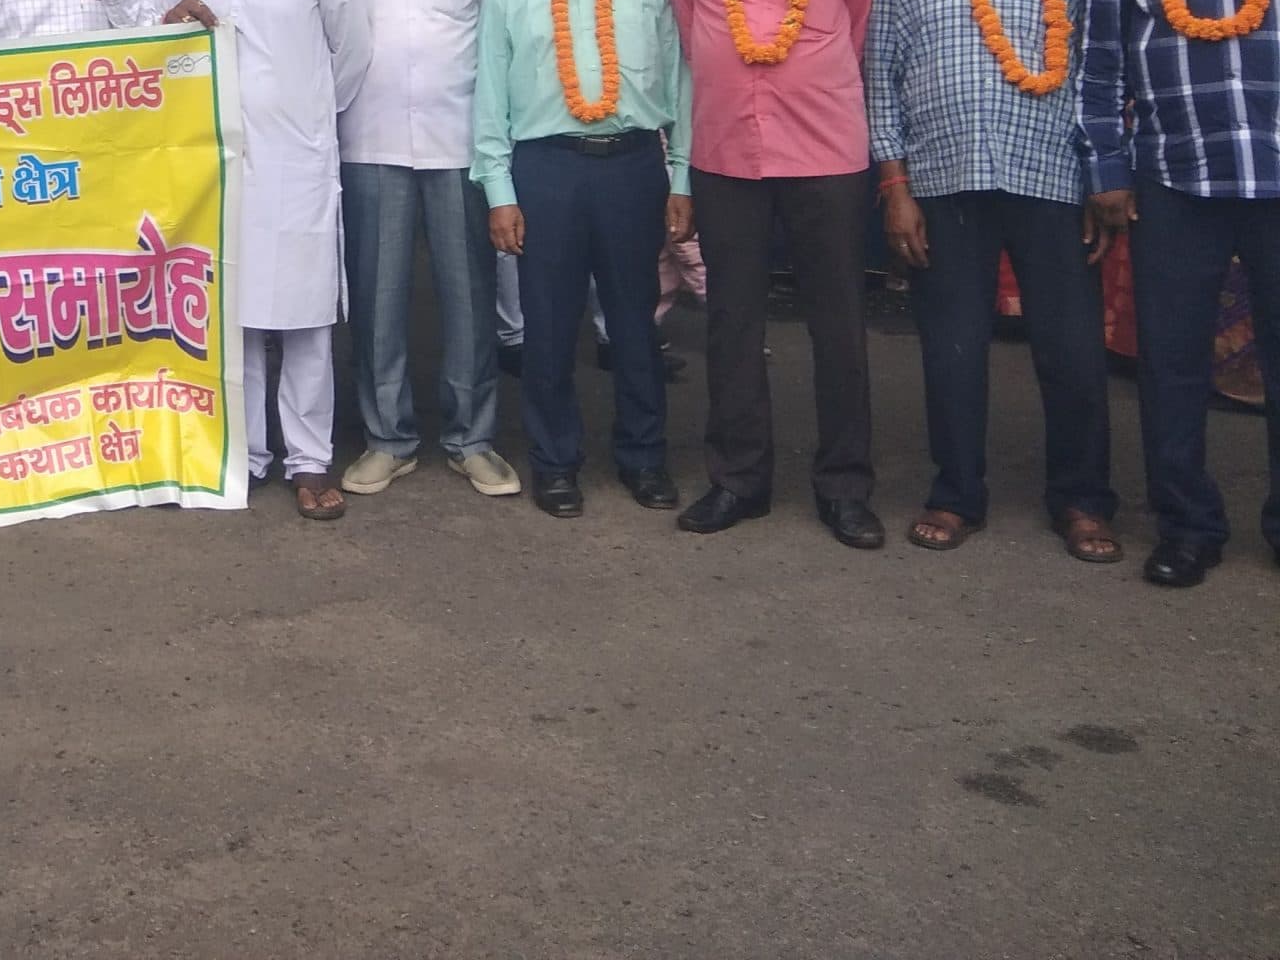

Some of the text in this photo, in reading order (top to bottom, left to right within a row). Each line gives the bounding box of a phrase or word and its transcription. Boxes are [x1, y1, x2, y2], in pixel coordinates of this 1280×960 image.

[50, 58, 163, 116] लिमिटेड
[13, 155, 80, 204] क्षेत्र
[89, 368, 215, 417] कार्यालय
[100, 421, 142, 464] क्षेत्र
